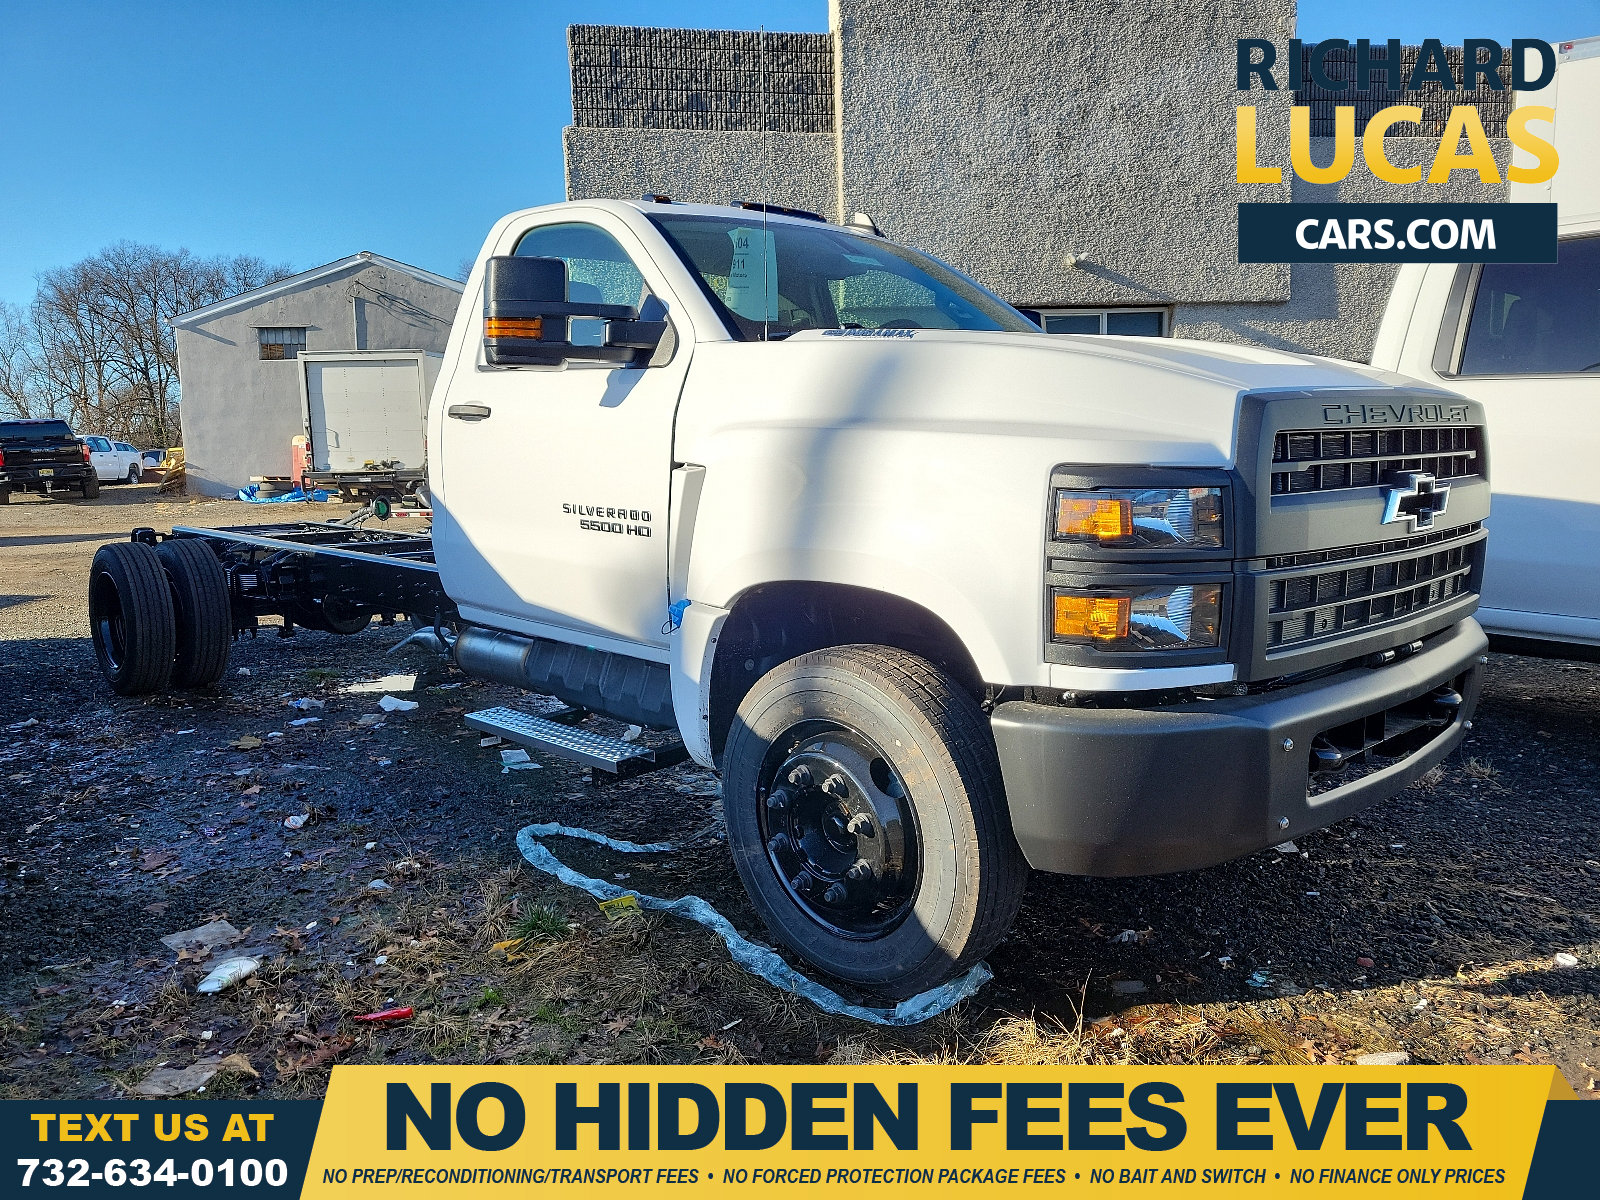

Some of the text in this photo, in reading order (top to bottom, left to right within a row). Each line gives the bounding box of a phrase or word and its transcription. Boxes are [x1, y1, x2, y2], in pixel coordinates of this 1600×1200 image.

[1321, 404, 1470, 425] CHEVROLET
[562, 502, 652, 522] SILVERADO
[580, 519, 652, 538] 5500 HD
